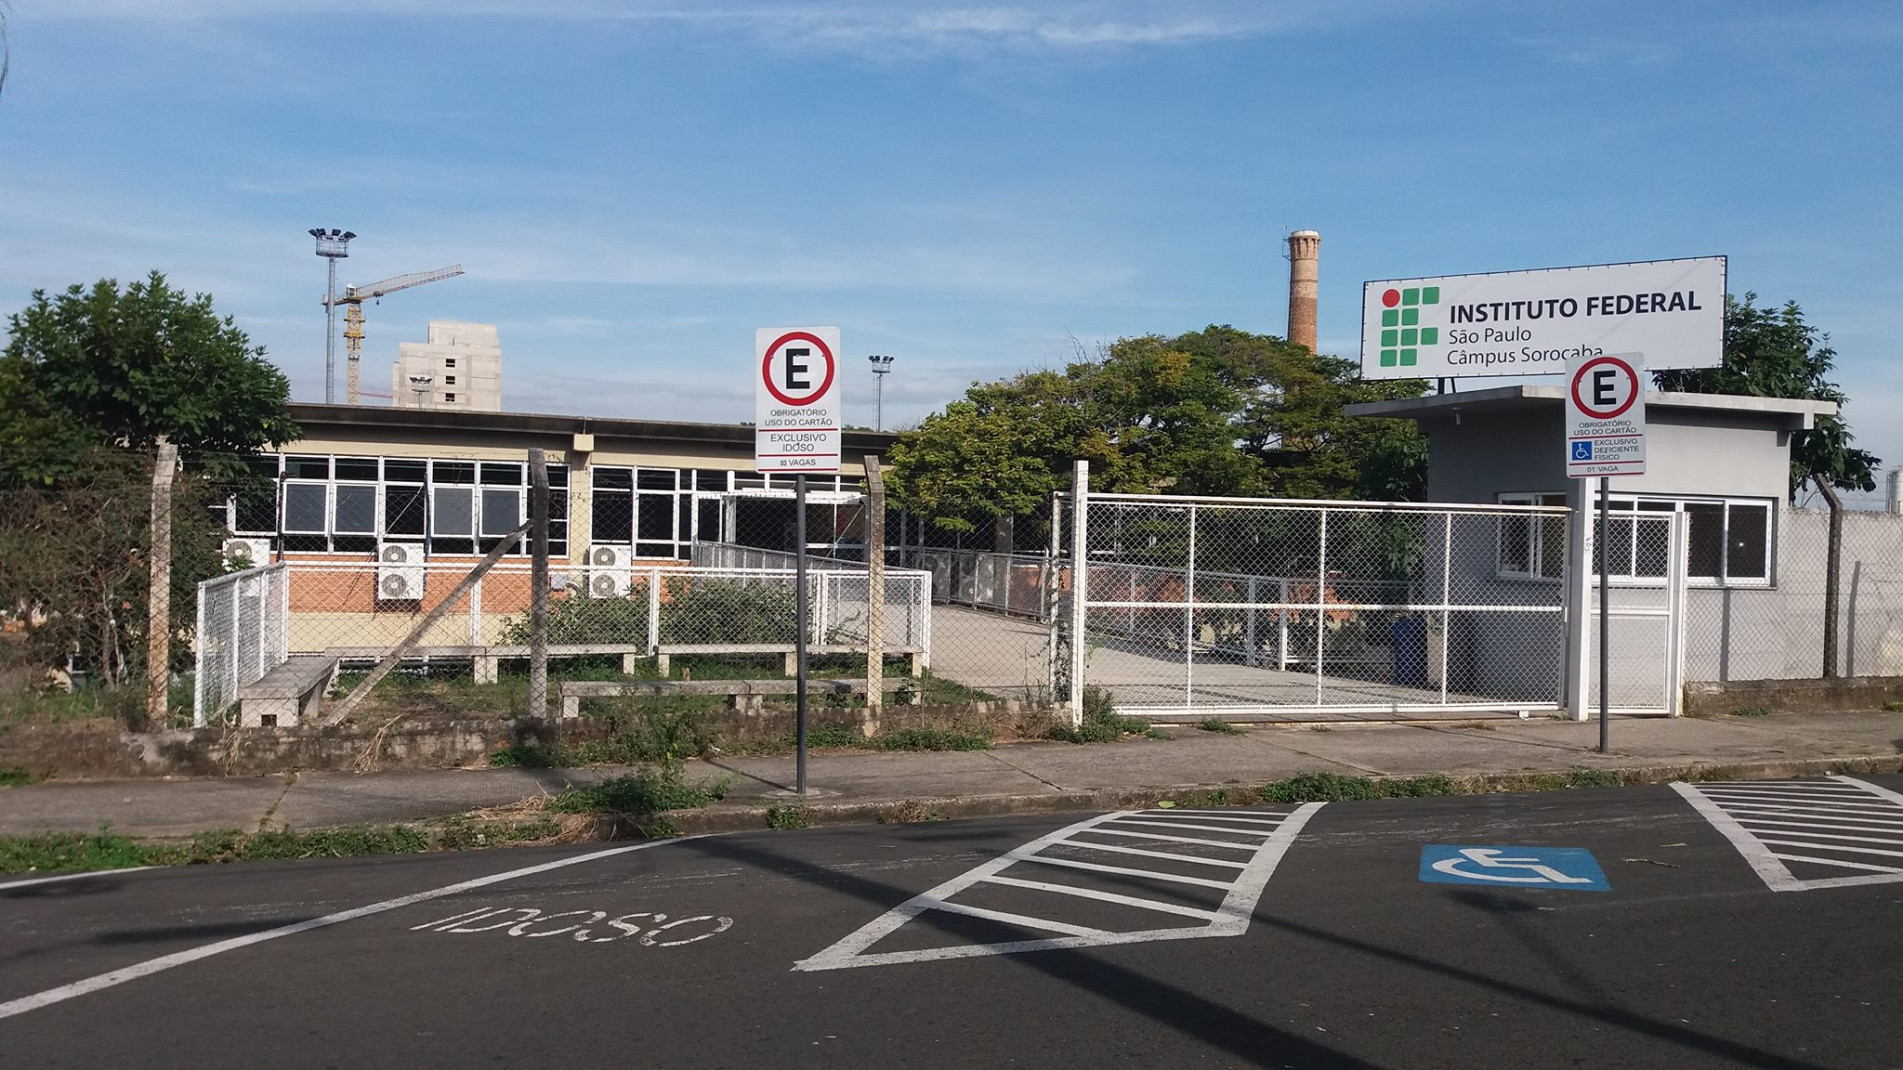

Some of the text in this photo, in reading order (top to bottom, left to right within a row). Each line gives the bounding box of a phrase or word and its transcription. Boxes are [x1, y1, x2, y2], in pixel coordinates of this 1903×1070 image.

[1450, 290, 1703, 324] INSTITUTO FEDERAL
[1449, 326, 1532, 345] São Paulo
[1447, 349, 1516, 368] Câmpus
[786, 348, 810, 389] E
[1593, 370, 1616, 405] E
[770, 408, 827, 417] OBRIGATÓRIO
[765, 419, 783, 427] USO
[799, 417, 833, 426] CARTÃO
[1578, 420, 1632, 429] OBRIGATÓRIO
[1605, 426, 1637, 435] CARTÃO
[770, 433, 827, 442] EXCLUSIVO
[1594, 438, 1638, 446] EXCLUSIVO
[1594, 445, 1640, 454] DEFICIENTE
[788, 458, 816, 467] VAGAS
[409, 906, 734, 947] IDOSO
